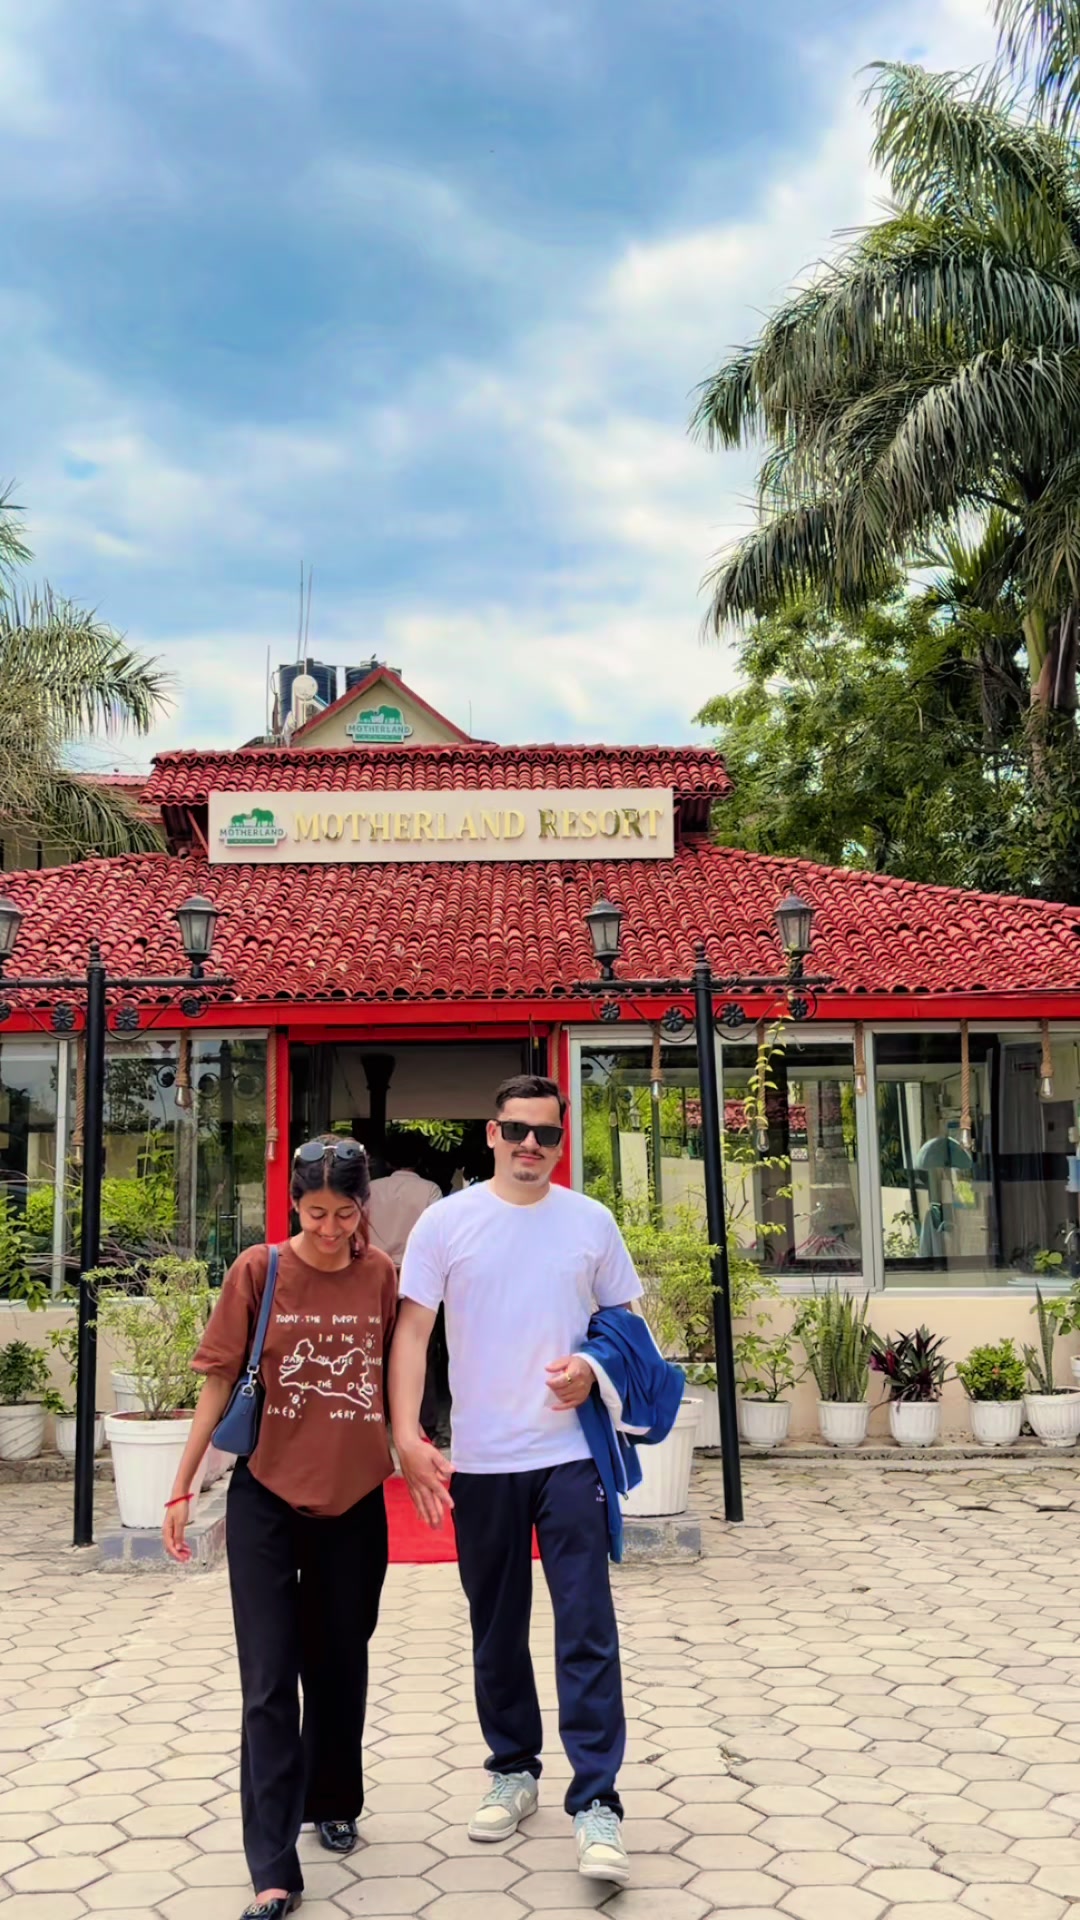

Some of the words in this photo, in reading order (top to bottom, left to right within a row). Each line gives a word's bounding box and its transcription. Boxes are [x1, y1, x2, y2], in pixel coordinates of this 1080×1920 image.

[348, 725, 411, 733] MOTHERLAND
[294, 809, 526, 842] MOTHERLAND
[538, 807, 664, 839] RESORT
[219, 828, 284, 837] MOTHERLAND
[330, 1409, 357, 1420] VERY
